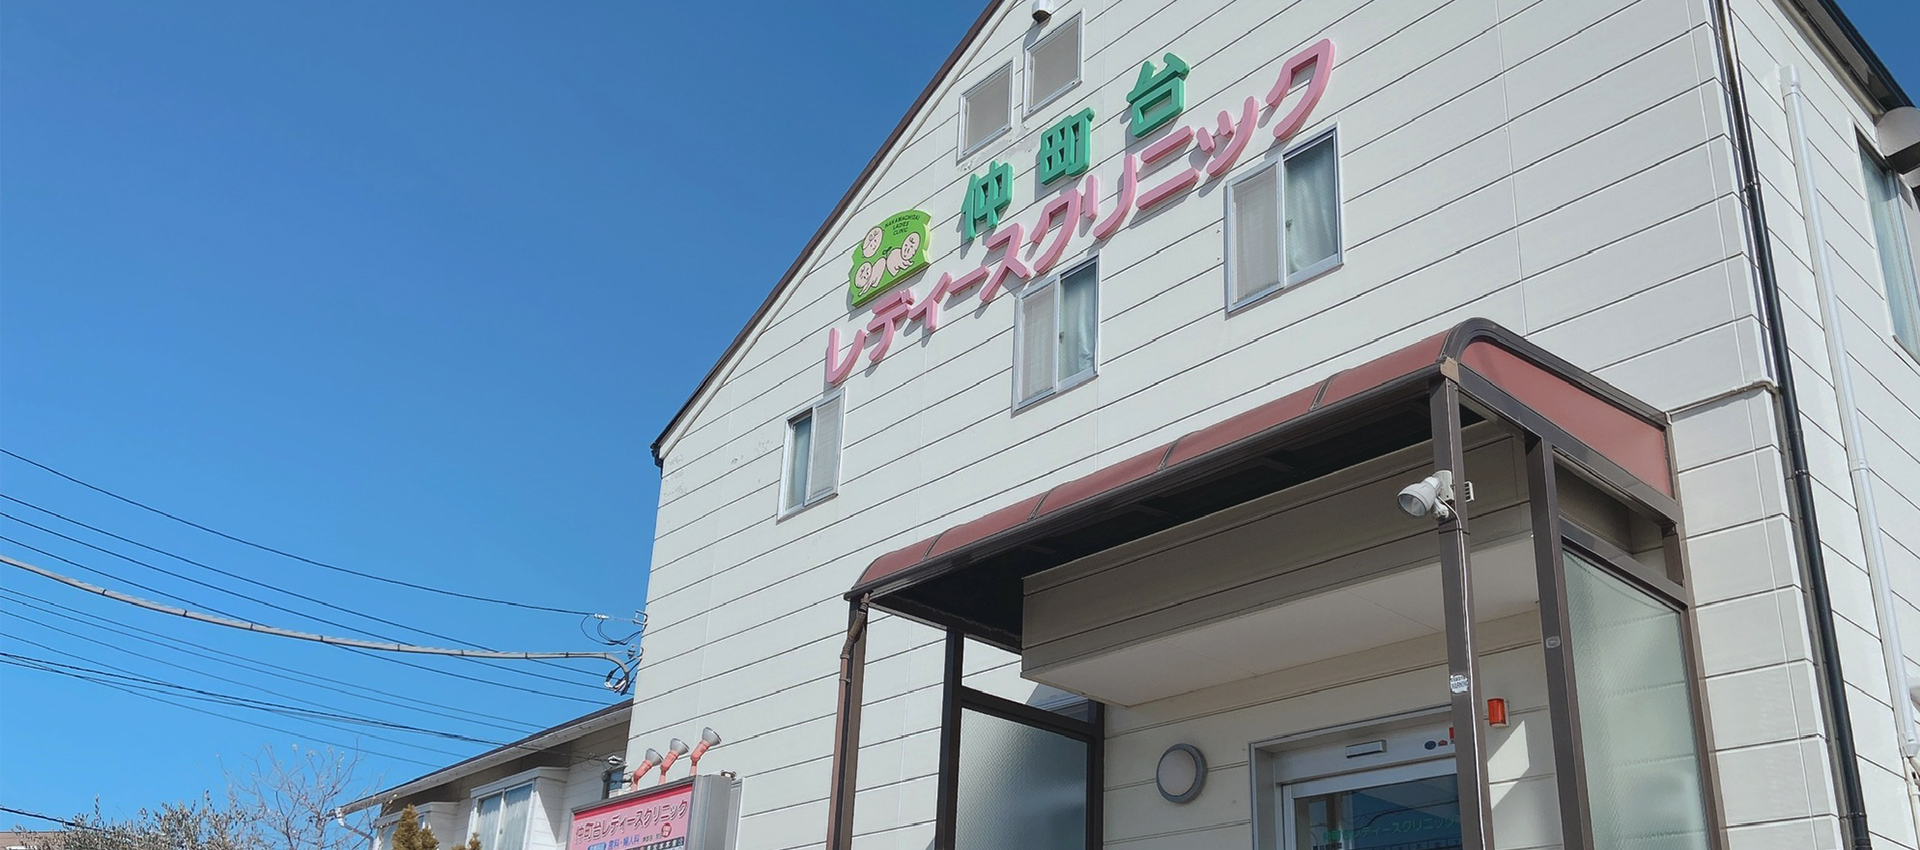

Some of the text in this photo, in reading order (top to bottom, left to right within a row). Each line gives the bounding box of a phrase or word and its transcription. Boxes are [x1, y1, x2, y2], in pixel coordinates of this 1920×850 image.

[961, 52, 1190, 241] 仲町台
[826, 38, 1335, 385] レディースクリニック
[892, 221, 910, 230] LADIES
[892, 227, 909, 236] CLINIC
[575, 800, 688, 844] 仲町台レディースクリニック
